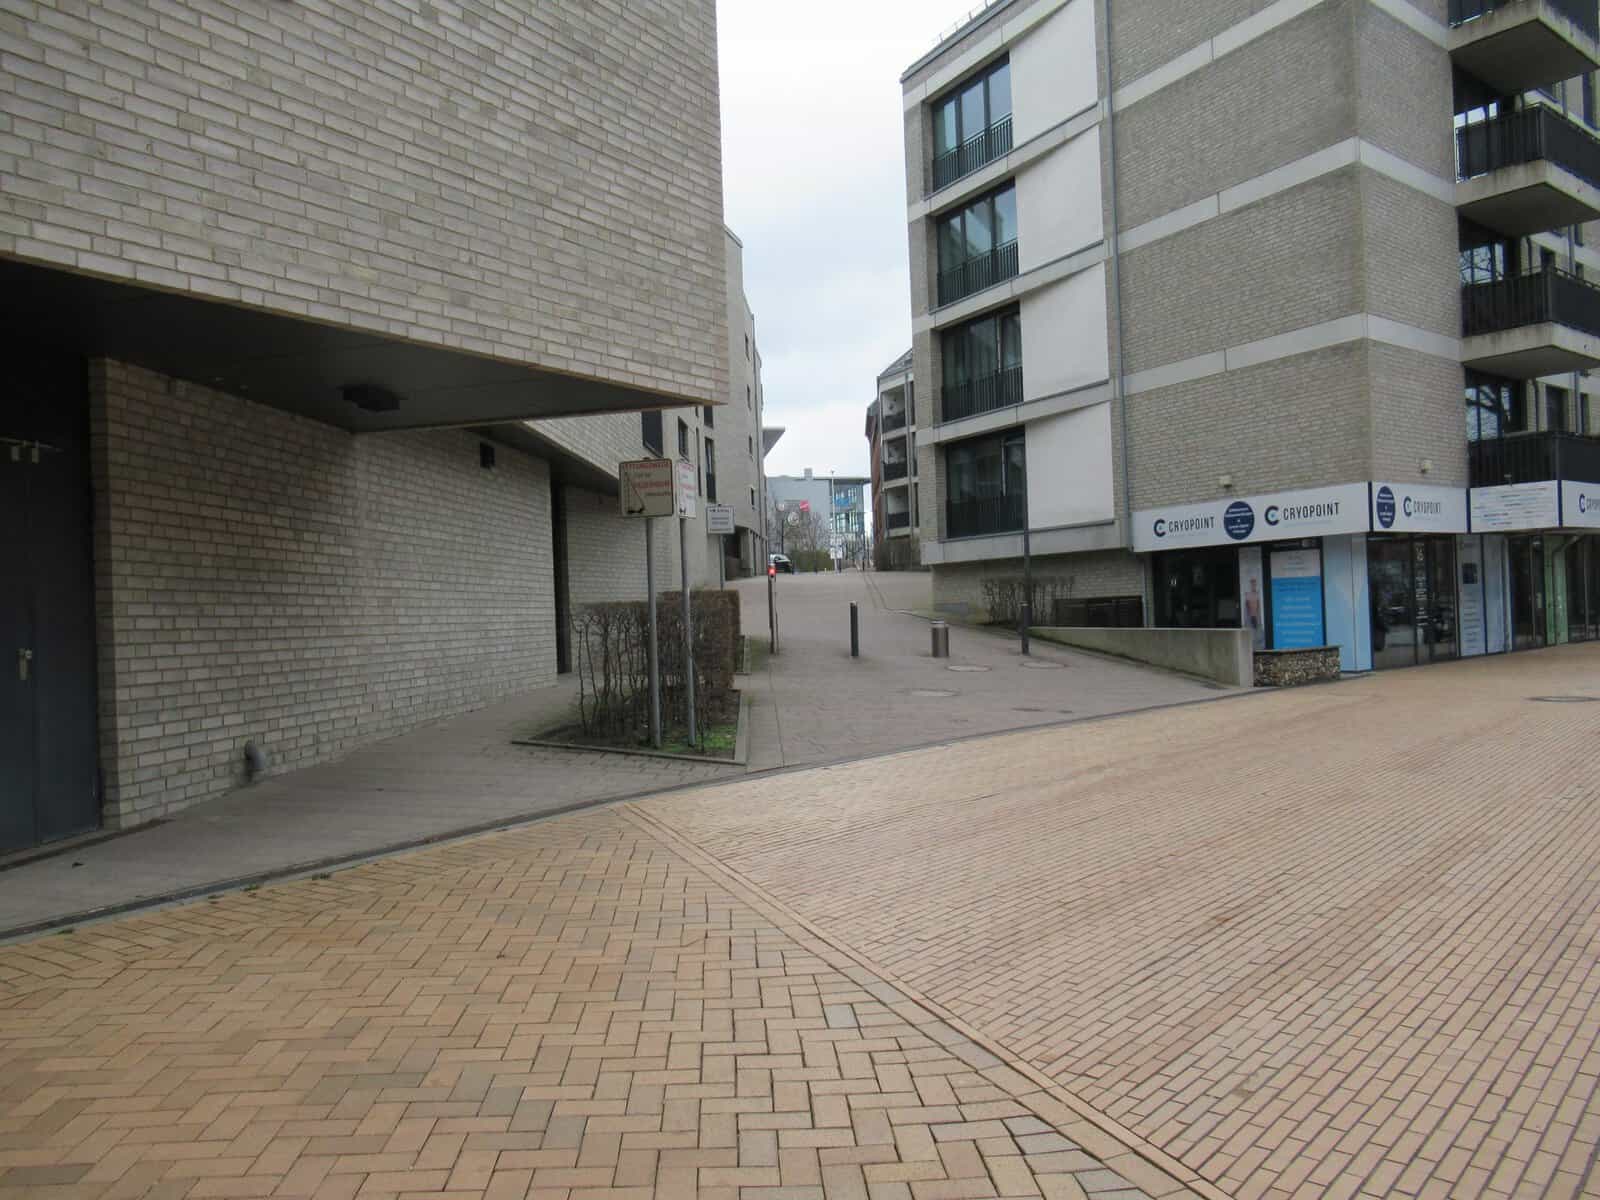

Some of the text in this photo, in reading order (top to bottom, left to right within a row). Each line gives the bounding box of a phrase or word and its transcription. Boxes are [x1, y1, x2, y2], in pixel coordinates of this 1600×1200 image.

[1283, 502, 1340, 521] CRYOPOINT
[1413, 501, 1441, 514] CRYOPOINT
[1168, 516, 1215, 533] CRYOPOINT
